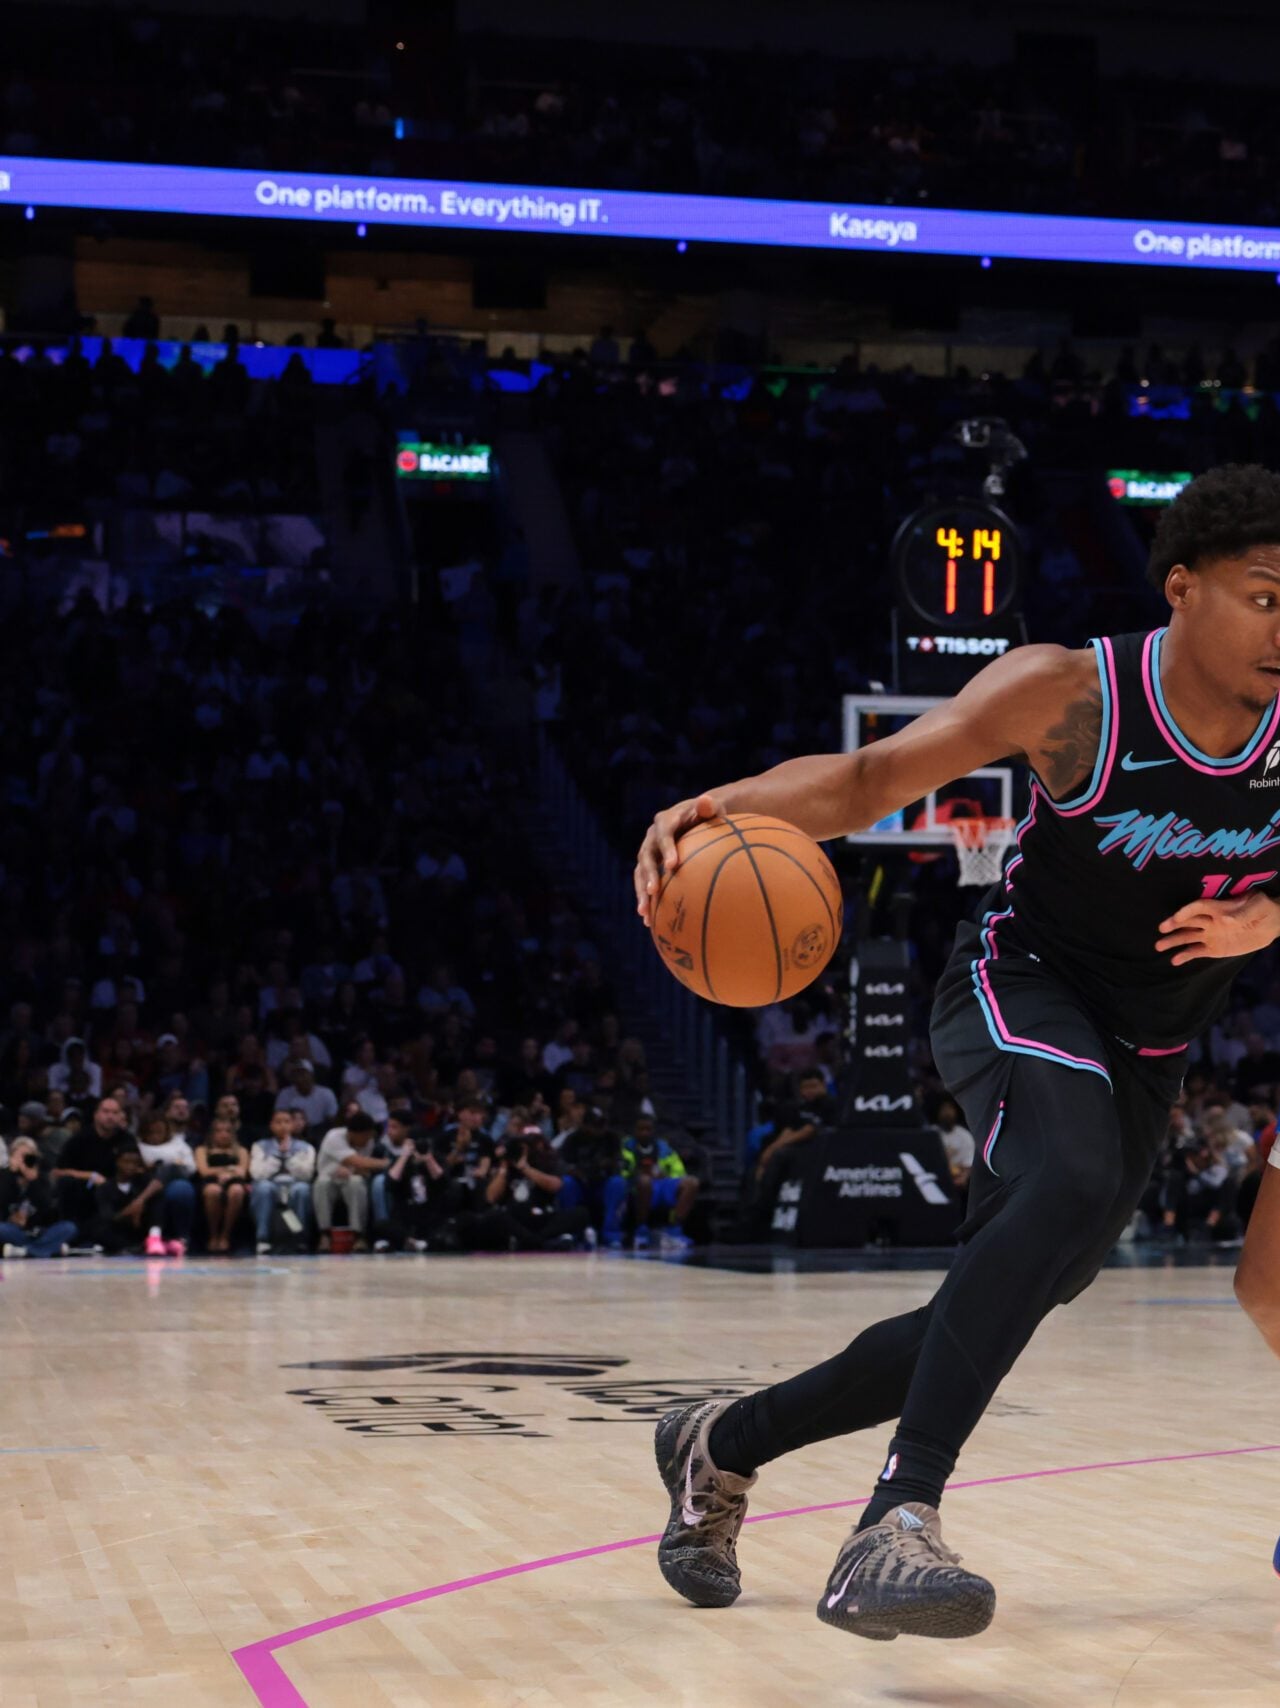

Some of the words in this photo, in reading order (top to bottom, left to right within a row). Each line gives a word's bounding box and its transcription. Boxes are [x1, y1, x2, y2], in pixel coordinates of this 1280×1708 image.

[255, 180, 311, 206] One
[315, 184, 435, 214] platform.
[441, 190, 576, 226] Everything
[579, 198, 609, 223] IT.
[829, 212, 917, 246] Kaseya
[1134, 229, 1185, 254] One
[937, 527, 1001, 561] 4:14
[945, 559, 994, 616] 11
[934, 636, 1010, 656] TISSOT
[823, 1165, 902, 1182] American
[839, 1180, 902, 1198] Airlines
[286, 1384, 554, 1438] Center
